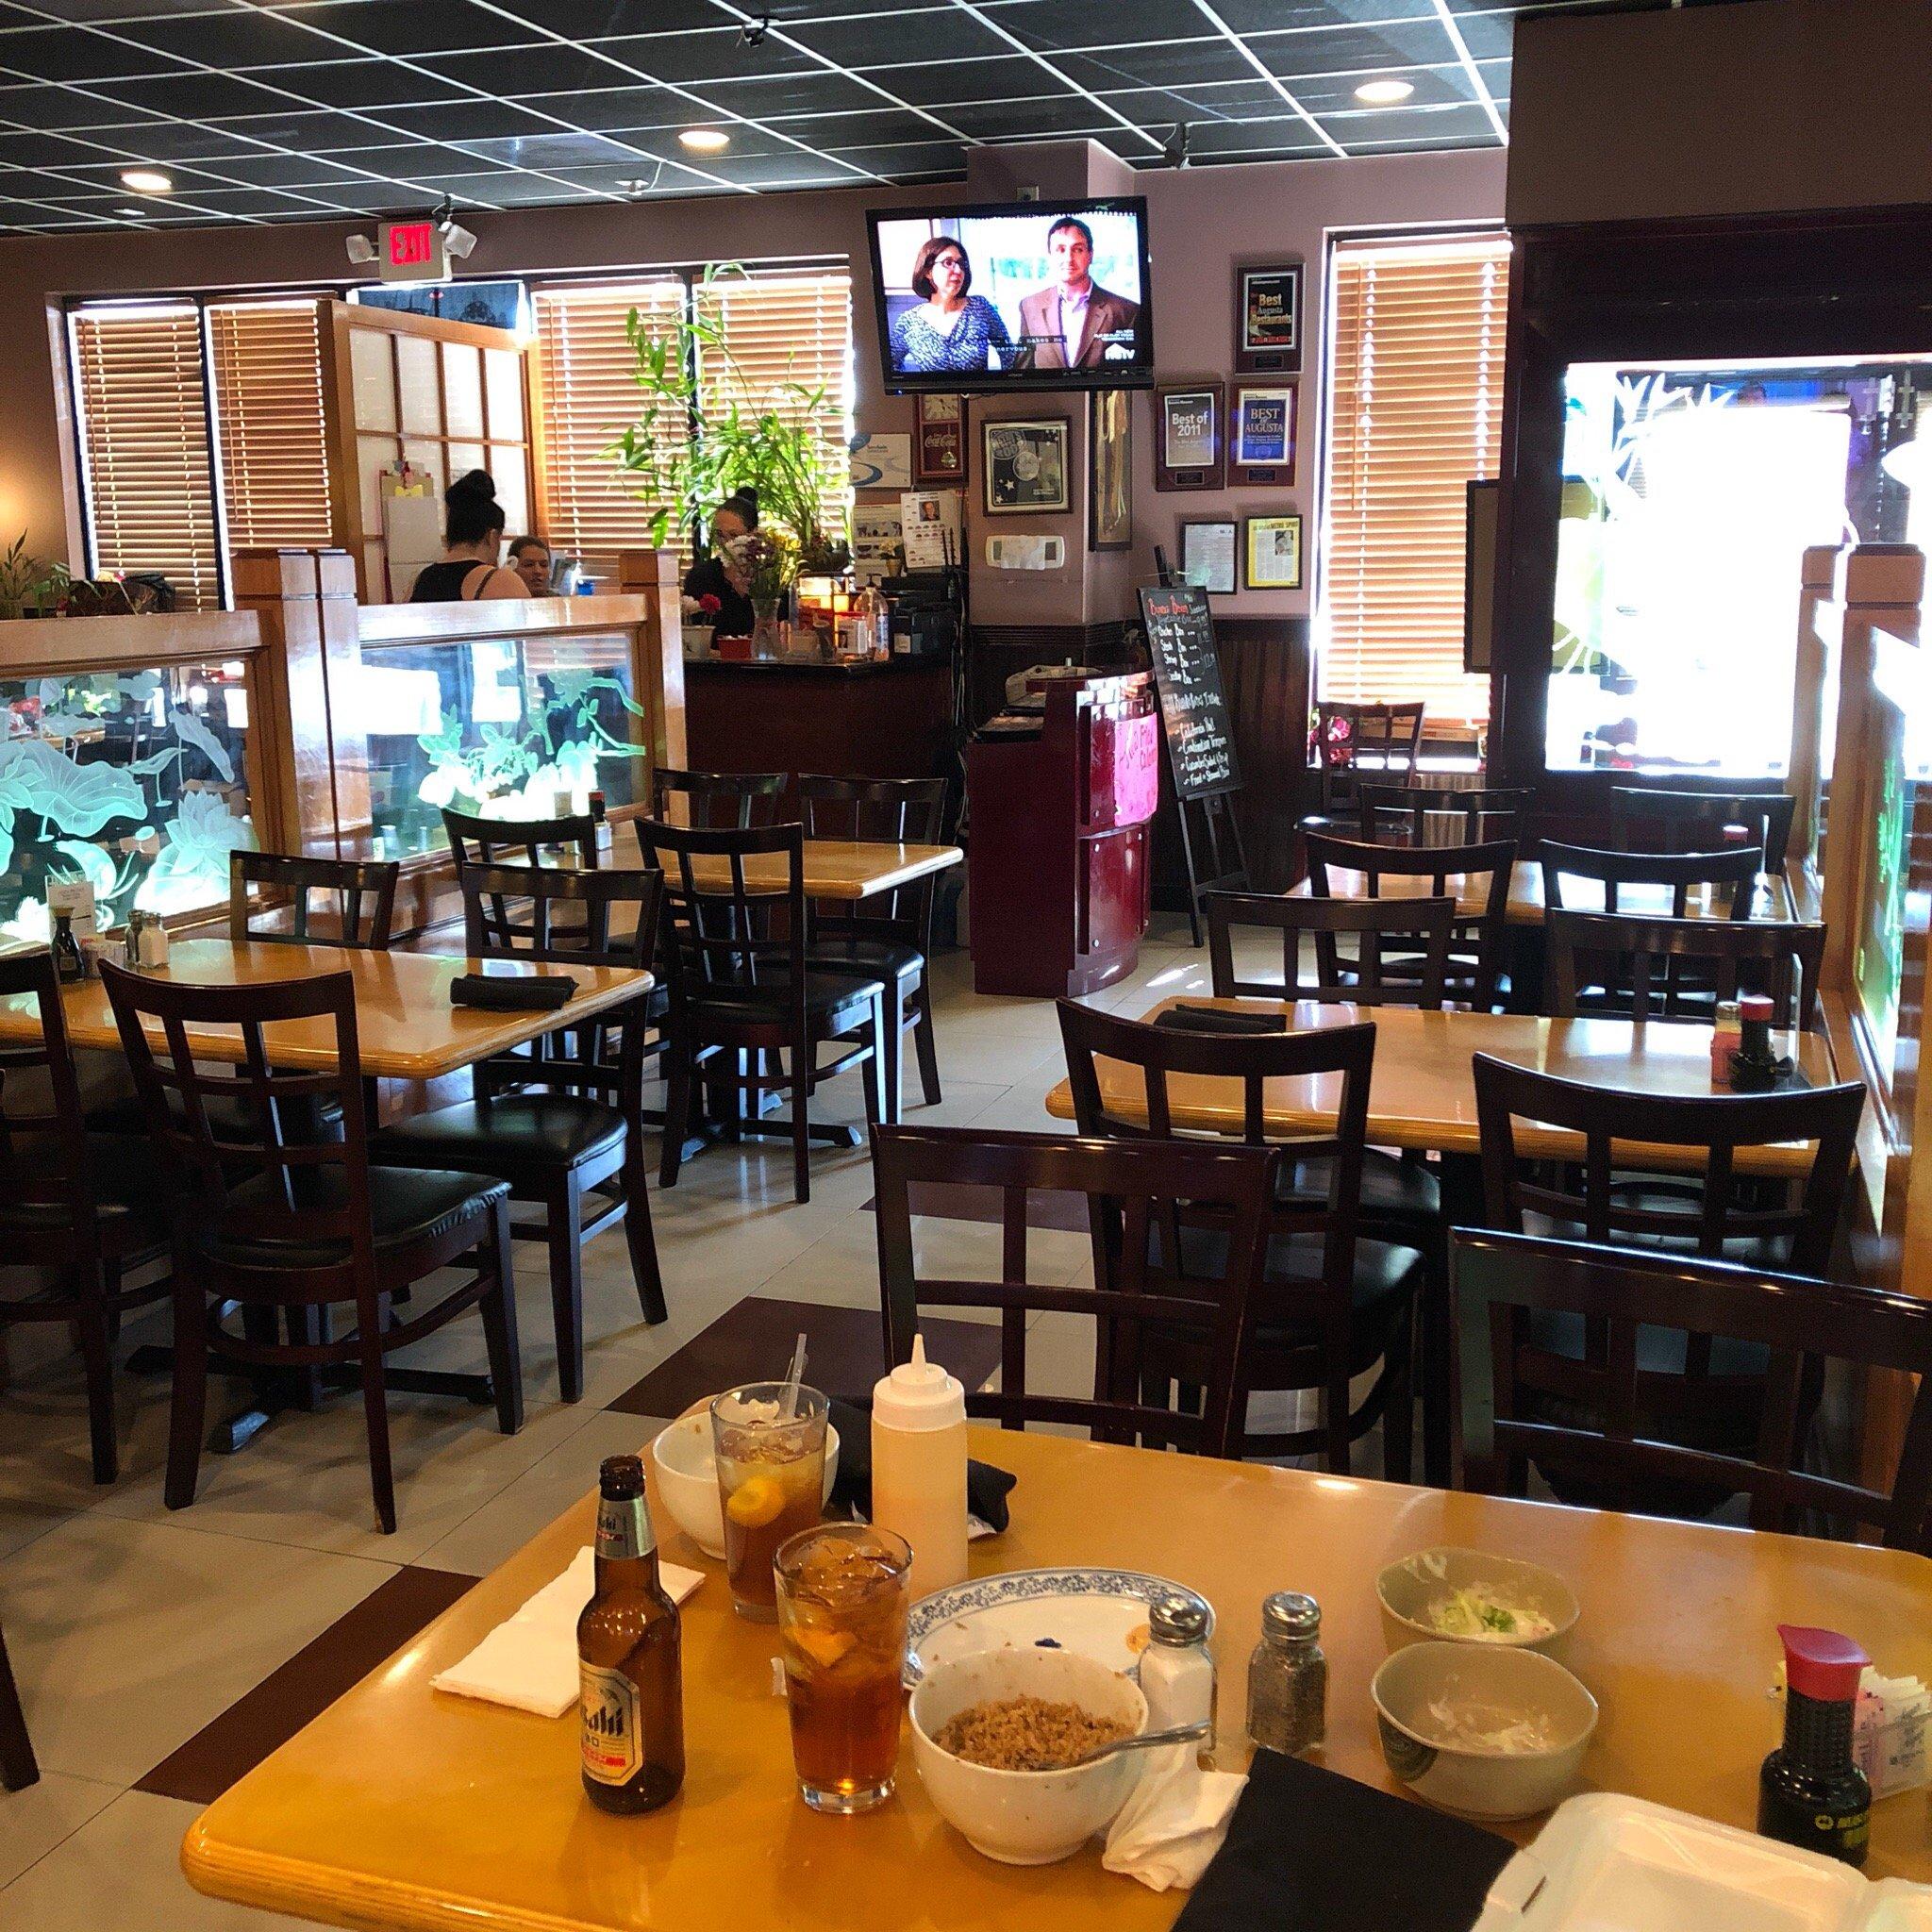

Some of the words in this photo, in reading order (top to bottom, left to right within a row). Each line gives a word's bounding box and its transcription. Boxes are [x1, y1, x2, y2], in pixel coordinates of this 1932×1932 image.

[390, 222, 432, 266] EXIT
[1258, 293, 1282, 306] Best
[1172, 413, 1195, 425] Best
[1196, 411, 1208, 424] of
[1250, 408, 1280, 420] BEST
[1177, 425, 1201, 436] 2011
[1245, 423, 1284, 433] AUGUSTA
